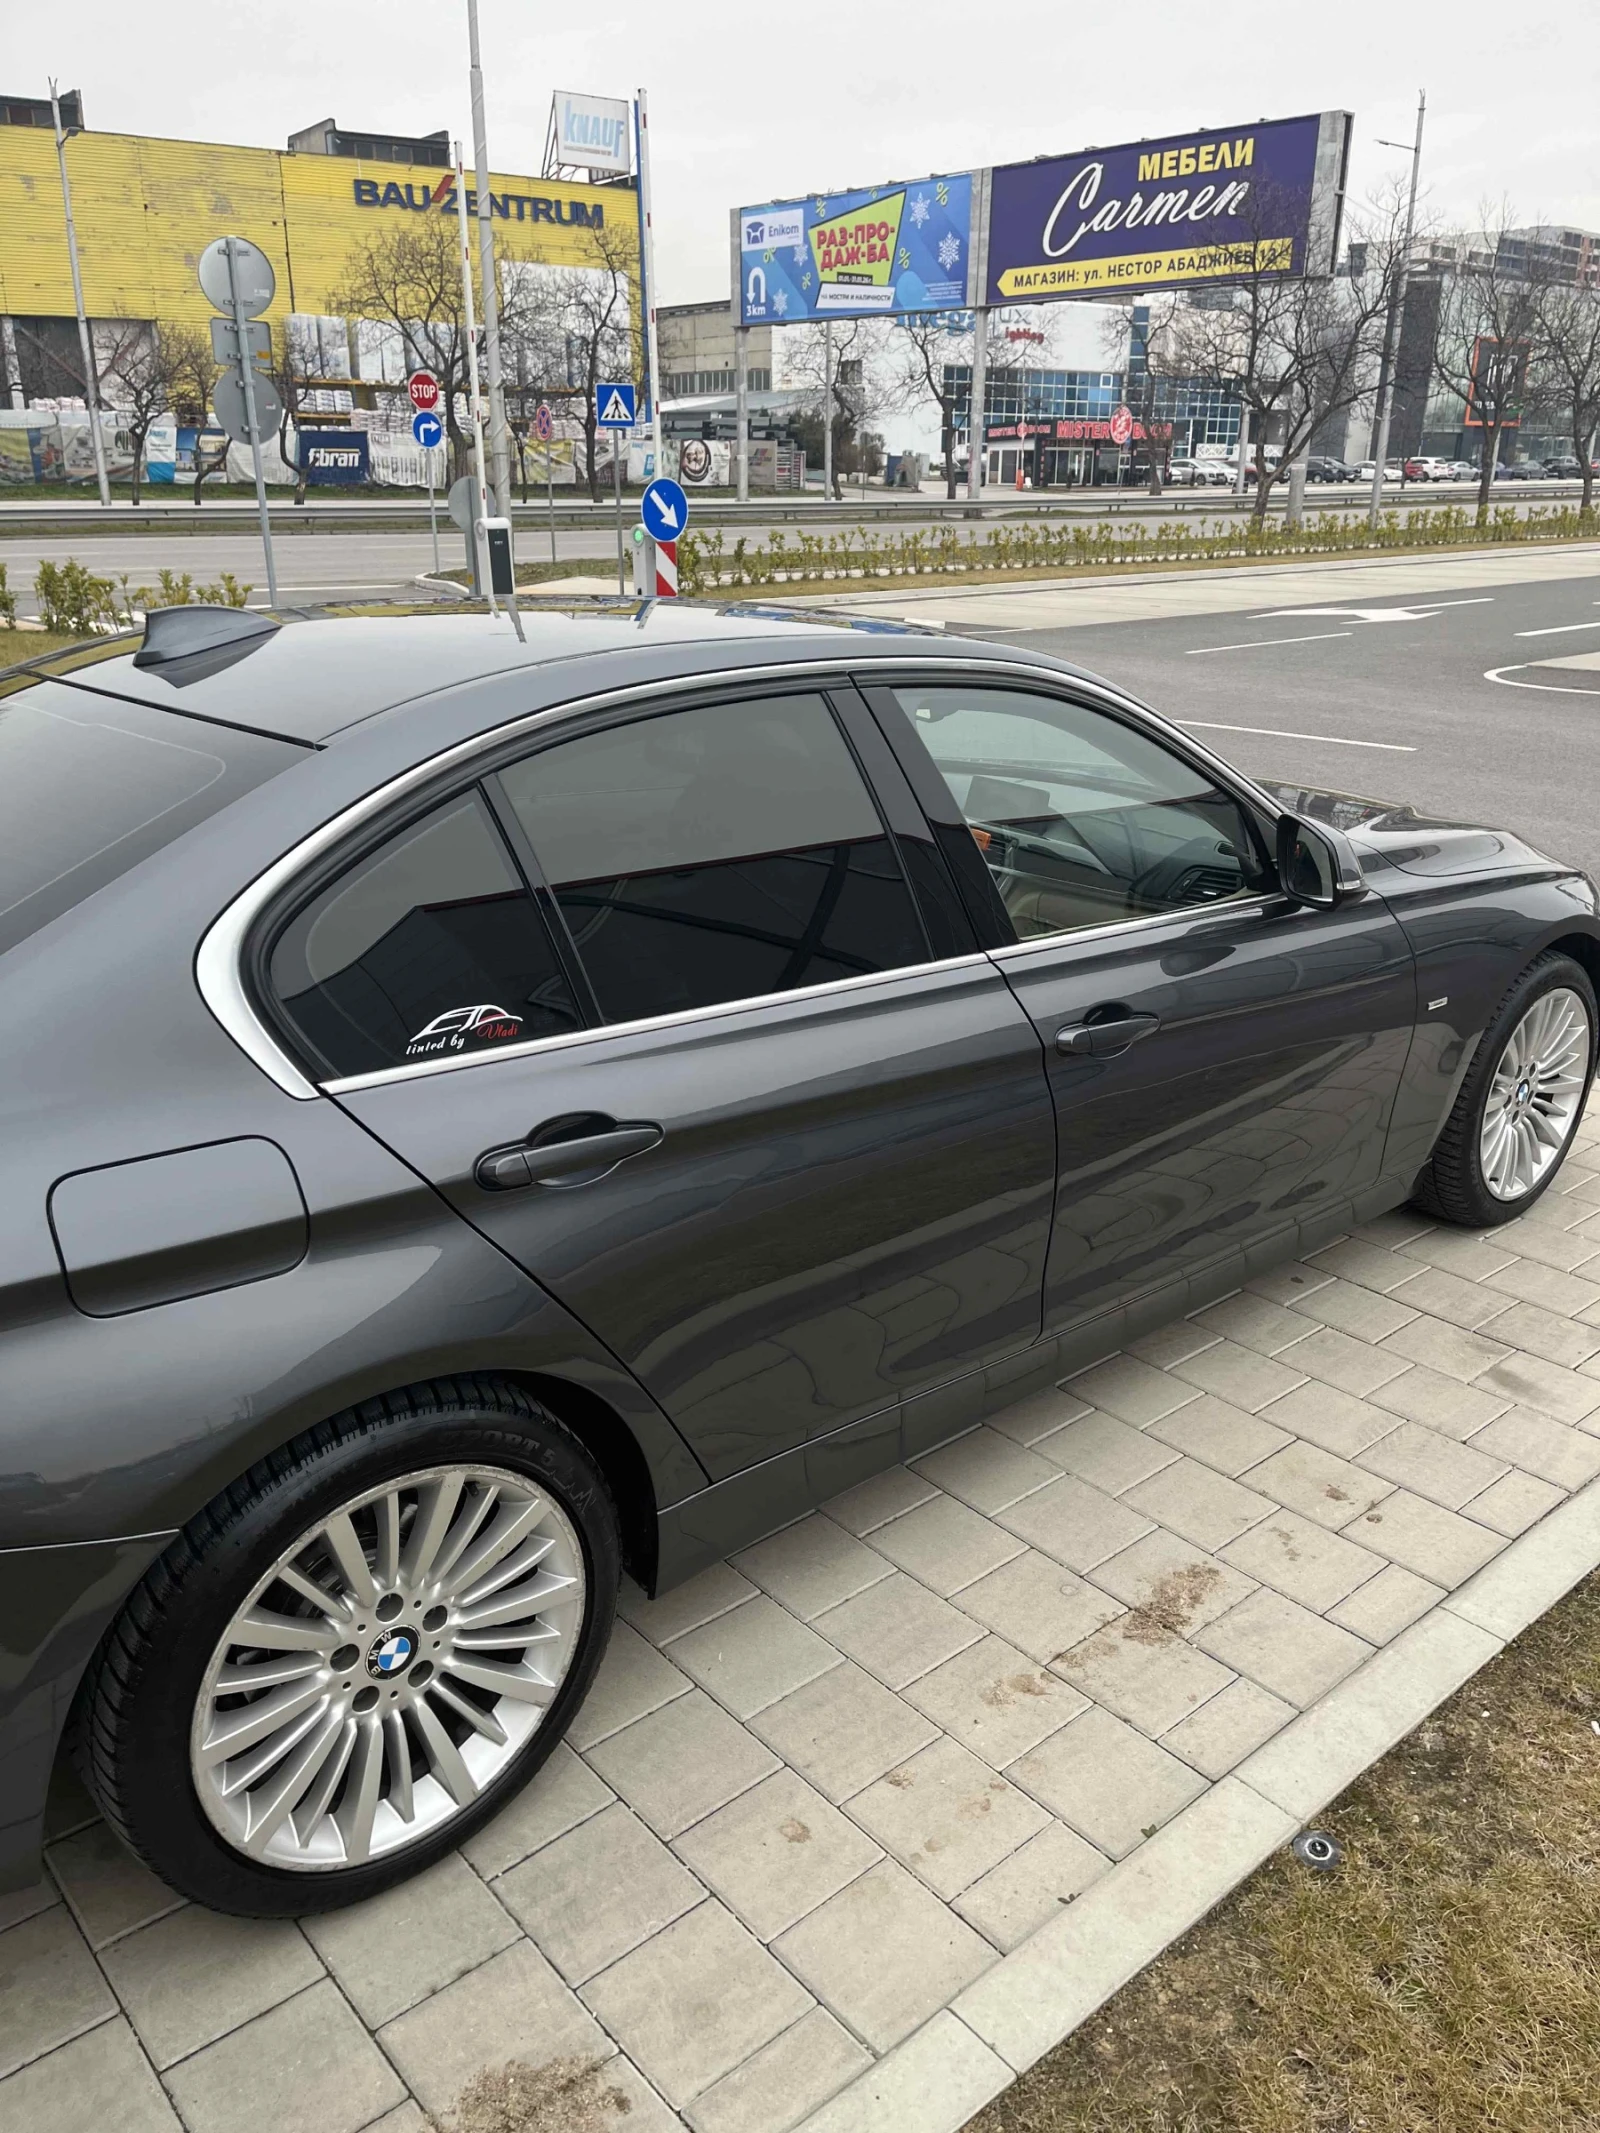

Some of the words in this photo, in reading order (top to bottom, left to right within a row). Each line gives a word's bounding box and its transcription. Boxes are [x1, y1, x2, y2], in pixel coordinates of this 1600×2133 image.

[564, 100, 624, 158] KNAUF
[1138, 138, 1255, 181] МЕБЕЛИ
[1042, 162, 1250, 257] Carmen
[768, 224, 800, 237] Enikom
[816, 221, 895, 249] РАЗ-ПРО-
[820, 242, 890, 272] ДАЖ-БА
[1013, 272, 1080, 288] МАГАЗИН:
[1083, 269, 1103, 285] ул.
[1107, 260, 1162, 278] НЕСТОР
[1167, 249, 1255, 273] АБАДЖИЕВ
[746, 305, 766, 316] 3km
[411, 384, 436, 399] STOP
[1056, 421, 1111, 439] MISTER
[308, 447, 360, 468] fibran
[450, 1033, 465, 1050] by
[477, 1023, 518, 1039] Vladi
[369, 1631, 392, 1677] BMW
